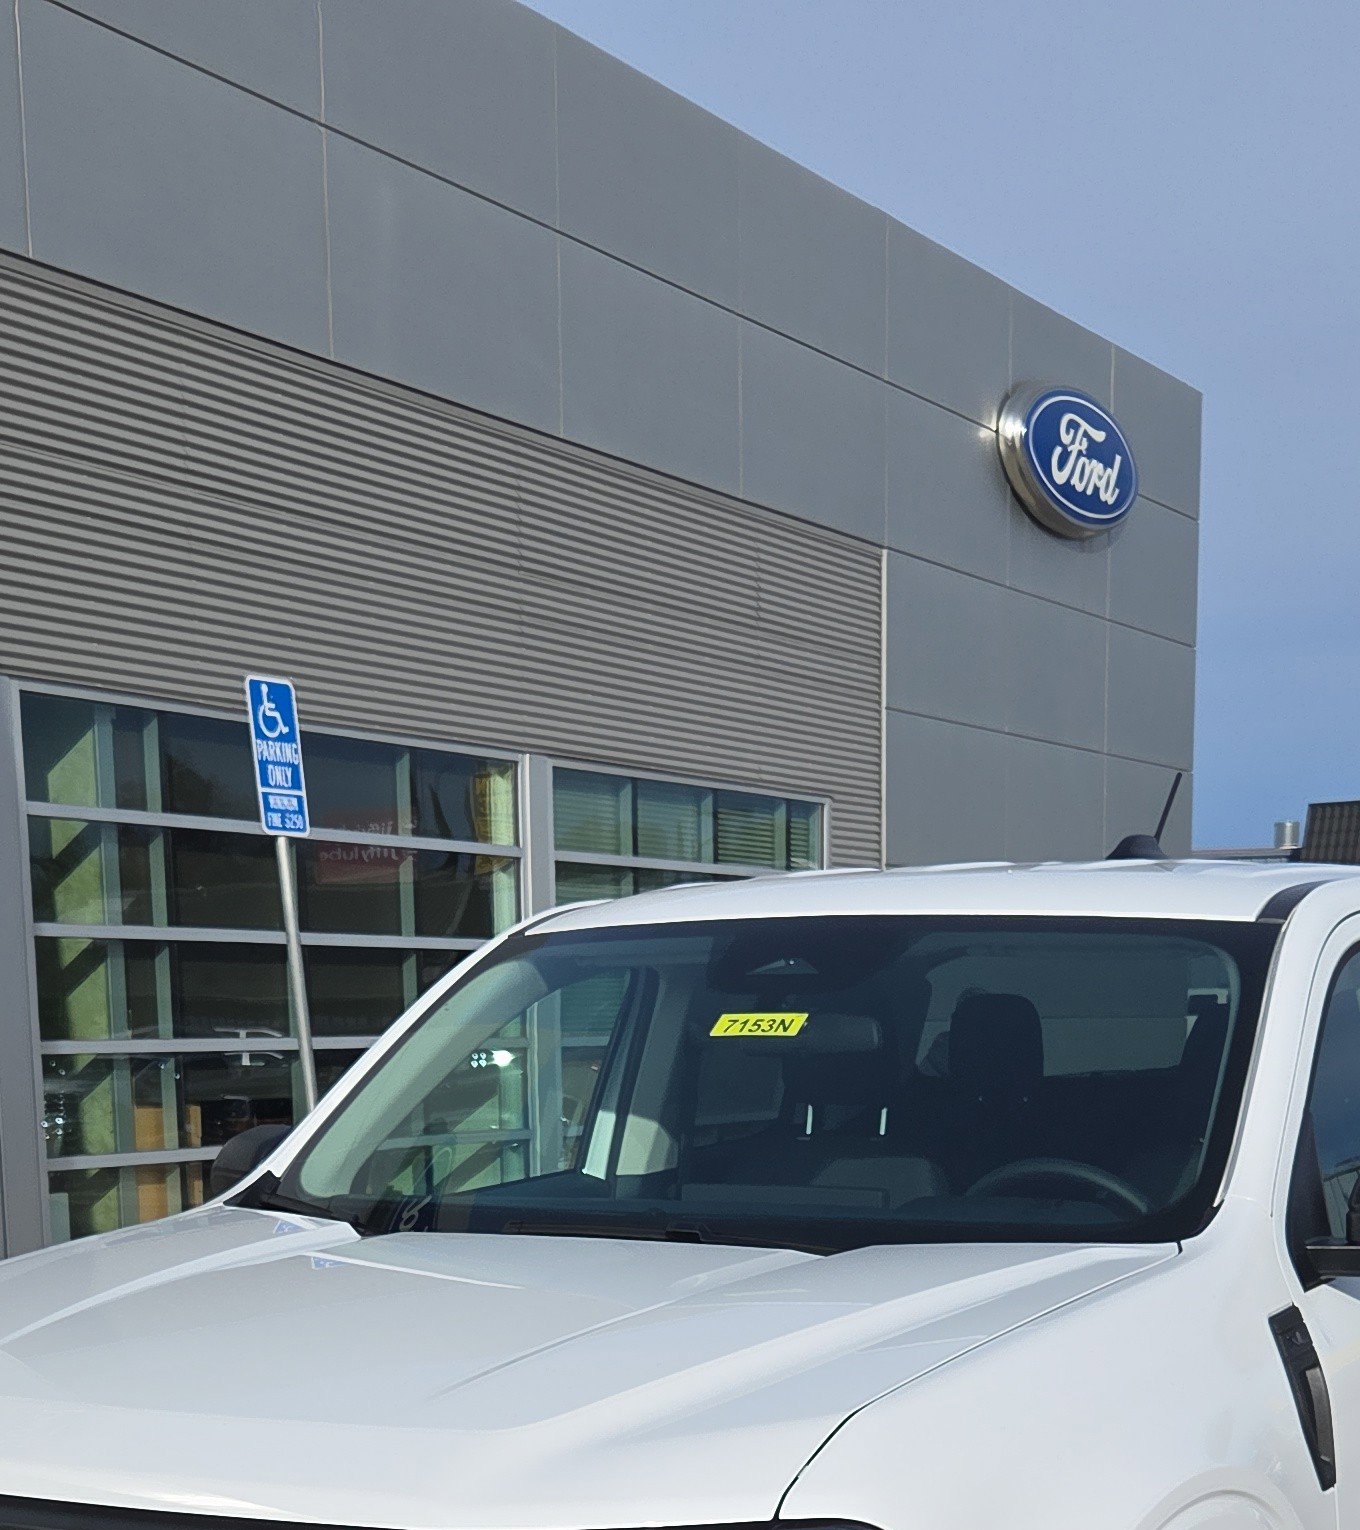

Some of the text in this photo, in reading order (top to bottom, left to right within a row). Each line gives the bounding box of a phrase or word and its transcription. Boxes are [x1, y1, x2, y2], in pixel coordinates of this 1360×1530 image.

[1051, 413, 1121, 505] Ford
[256, 739, 300, 765] PARKING
[267, 764, 292, 788] ONLY
[723, 1018, 795, 1033] 7153N
